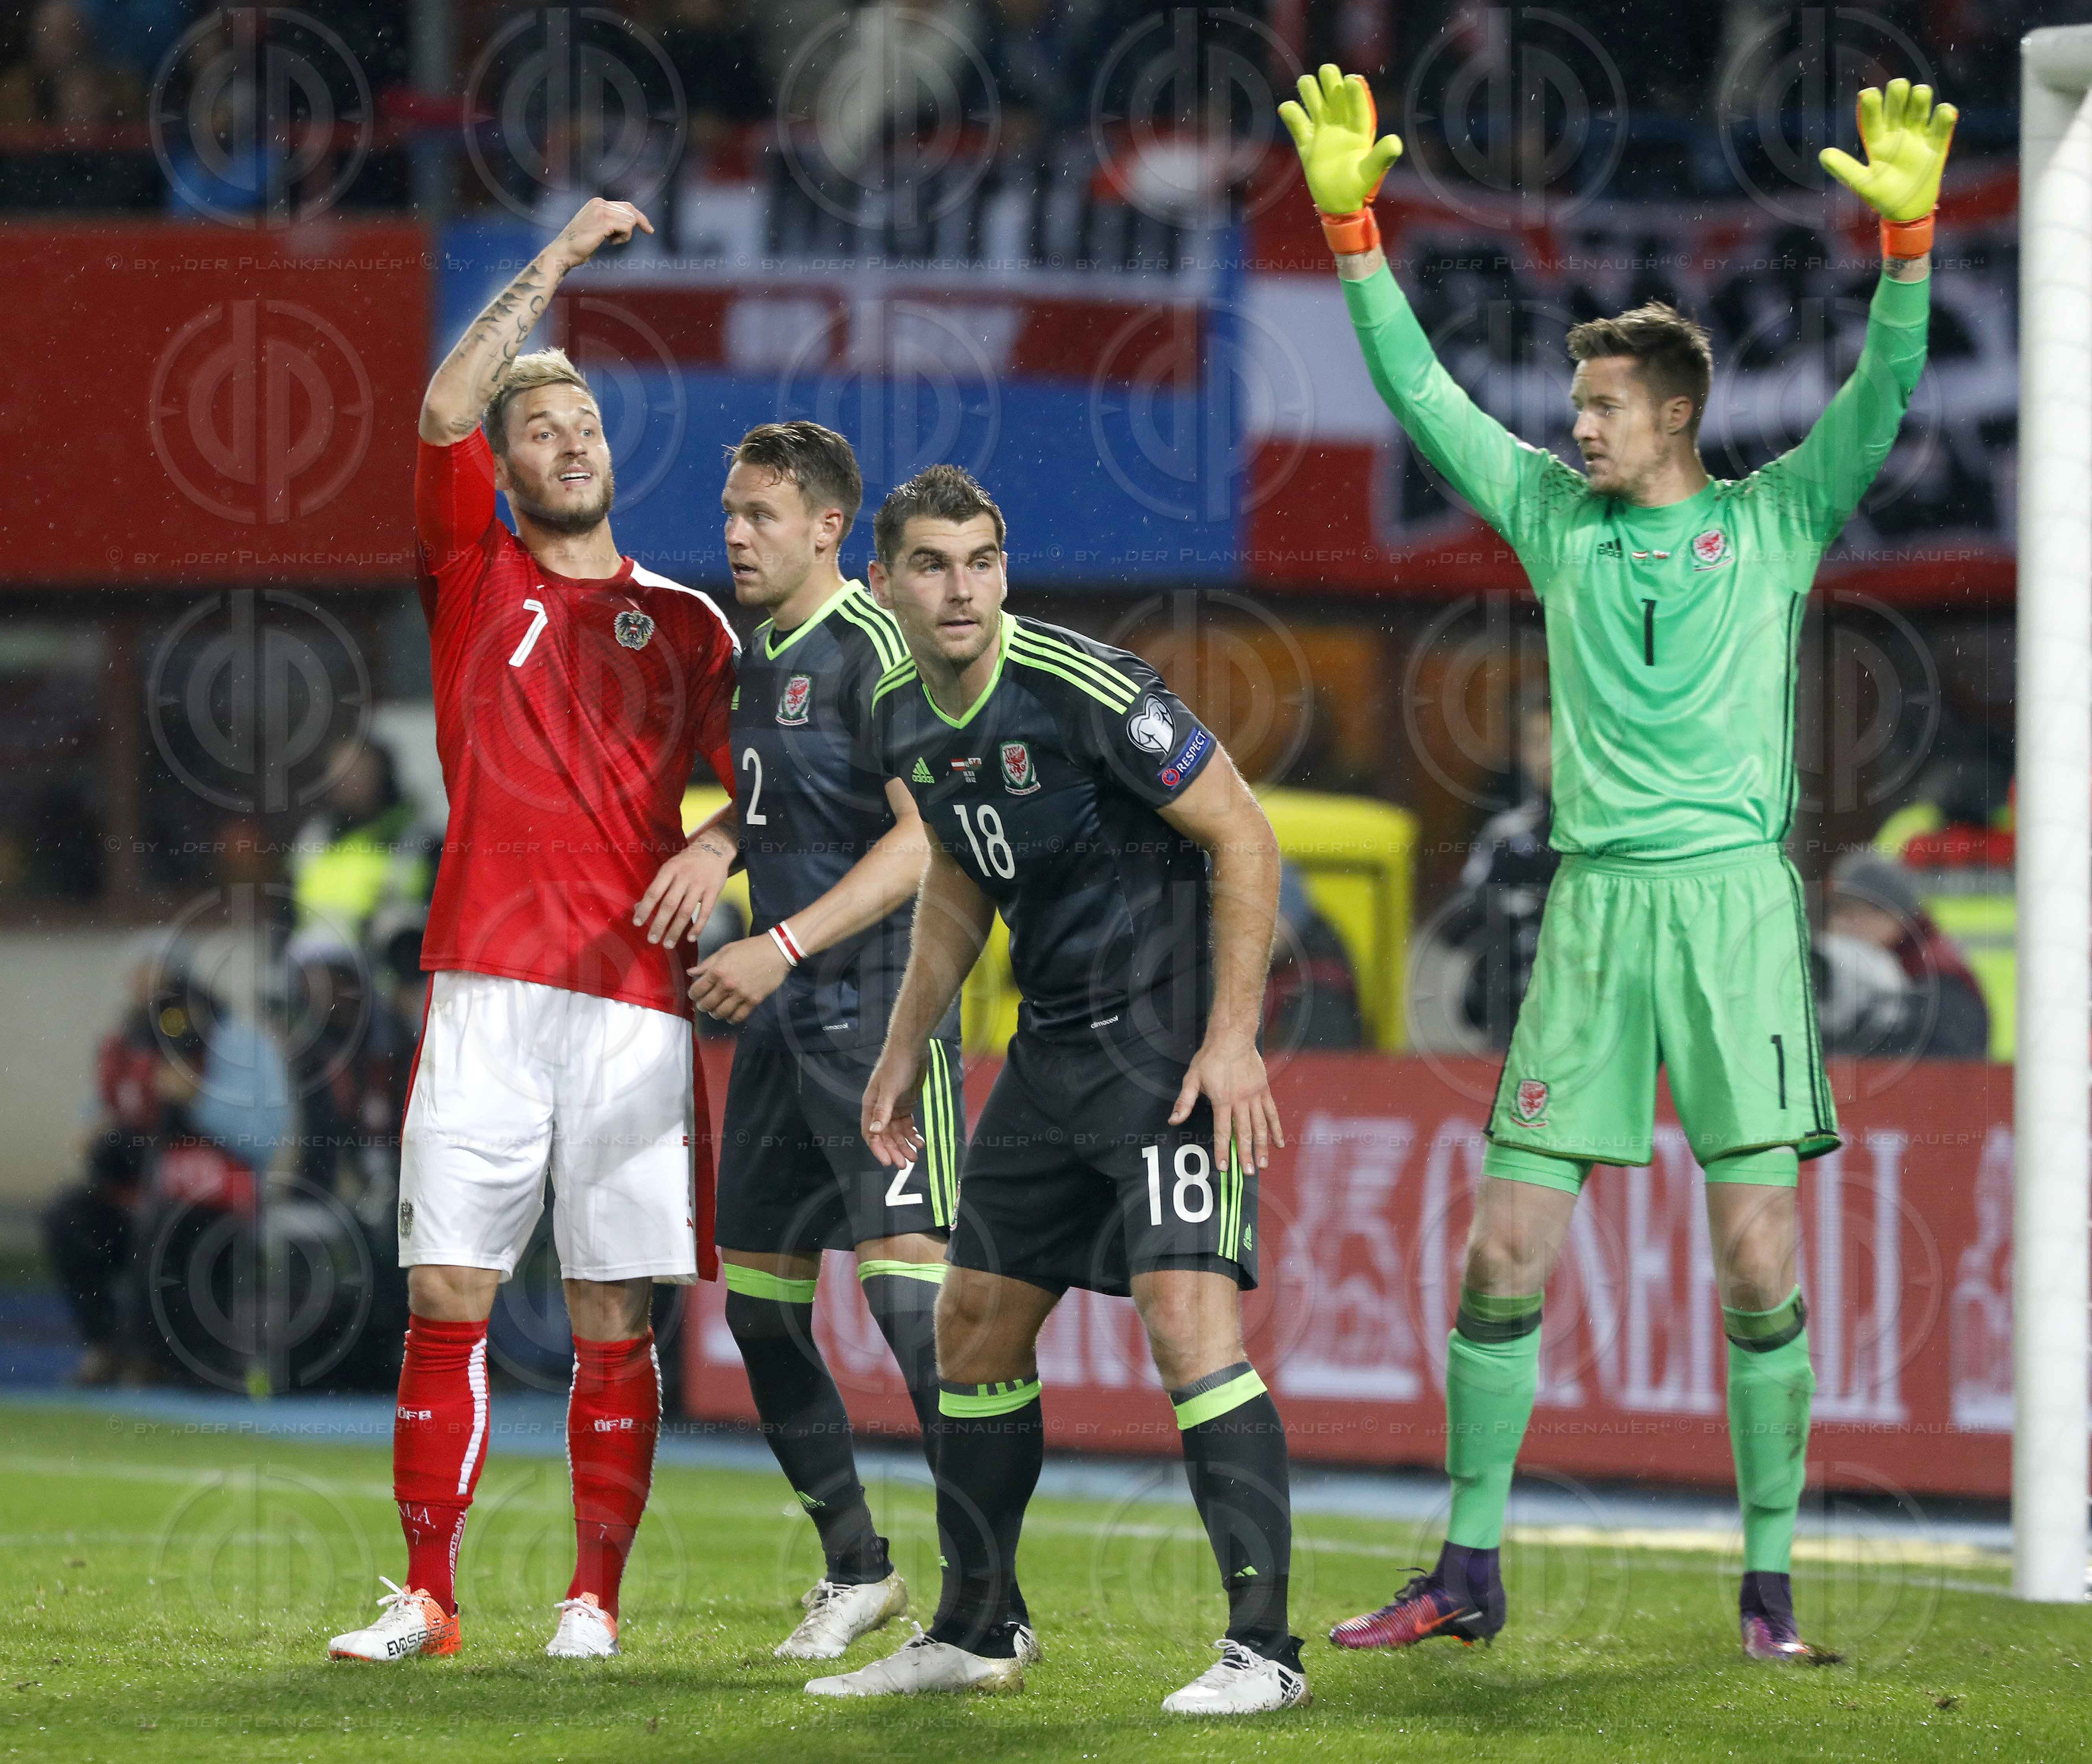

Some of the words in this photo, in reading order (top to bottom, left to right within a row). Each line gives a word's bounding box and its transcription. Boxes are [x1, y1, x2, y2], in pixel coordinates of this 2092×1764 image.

[508, 598, 549, 667] 7
[1640, 598, 1657, 666] 1
[742, 747, 767, 825] 2
[1176, 730, 1207, 773] RESPECT
[953, 804, 1016, 880] 18
[1771, 1034, 1786, 1110] 1
[885, 1125, 926, 1207] 2
[1141, 1143, 1214, 1226] 18
[397, 1406, 432, 1421] ÖFB
[594, 1418, 633, 1432] ÖFB
